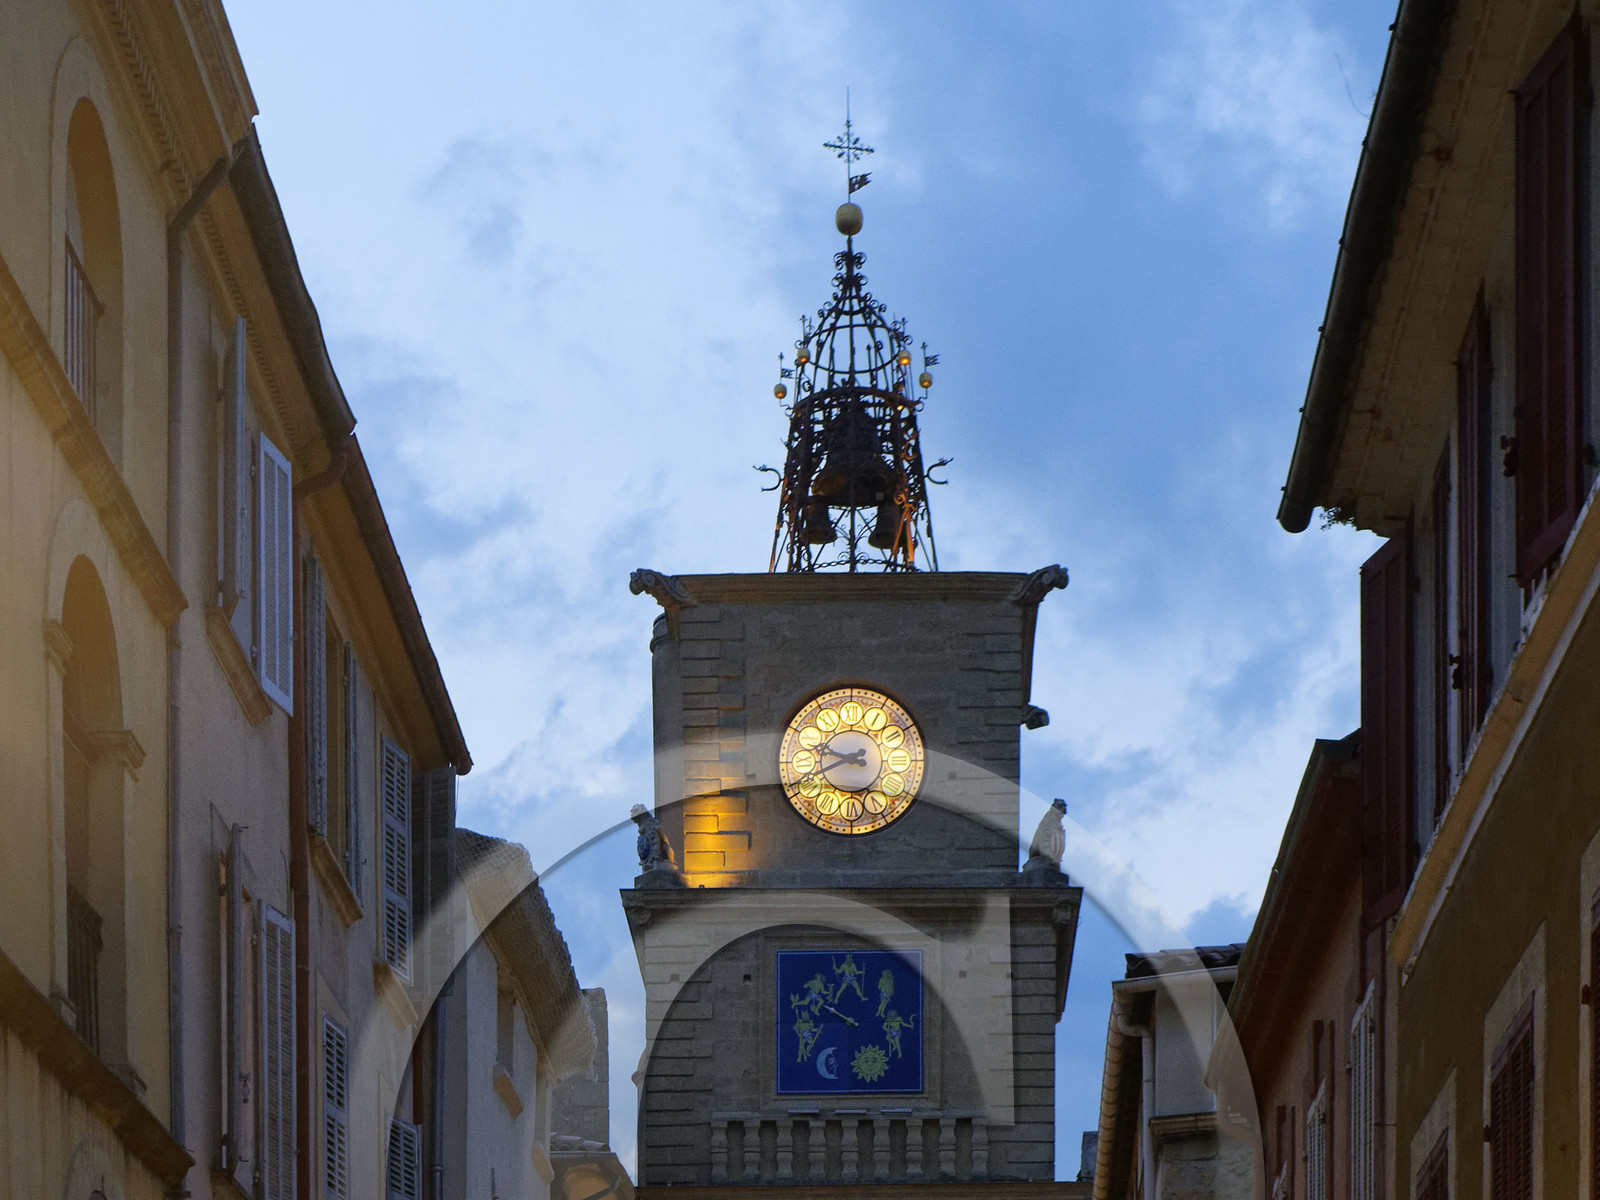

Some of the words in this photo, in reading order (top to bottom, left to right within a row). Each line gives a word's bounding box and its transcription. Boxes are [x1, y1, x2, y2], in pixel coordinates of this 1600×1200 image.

[817, 710, 836, 730] XI
[844, 705, 858, 722] XII
[871, 712, 881, 726] I
[885, 730, 901, 742] II
[795, 755, 812, 768] IX
[891, 755, 907, 766] III
[883, 776, 903, 794] IIII
[819, 793, 835, 813] VII
[846, 801, 859, 817] VI
[870, 796, 883, 812] V
